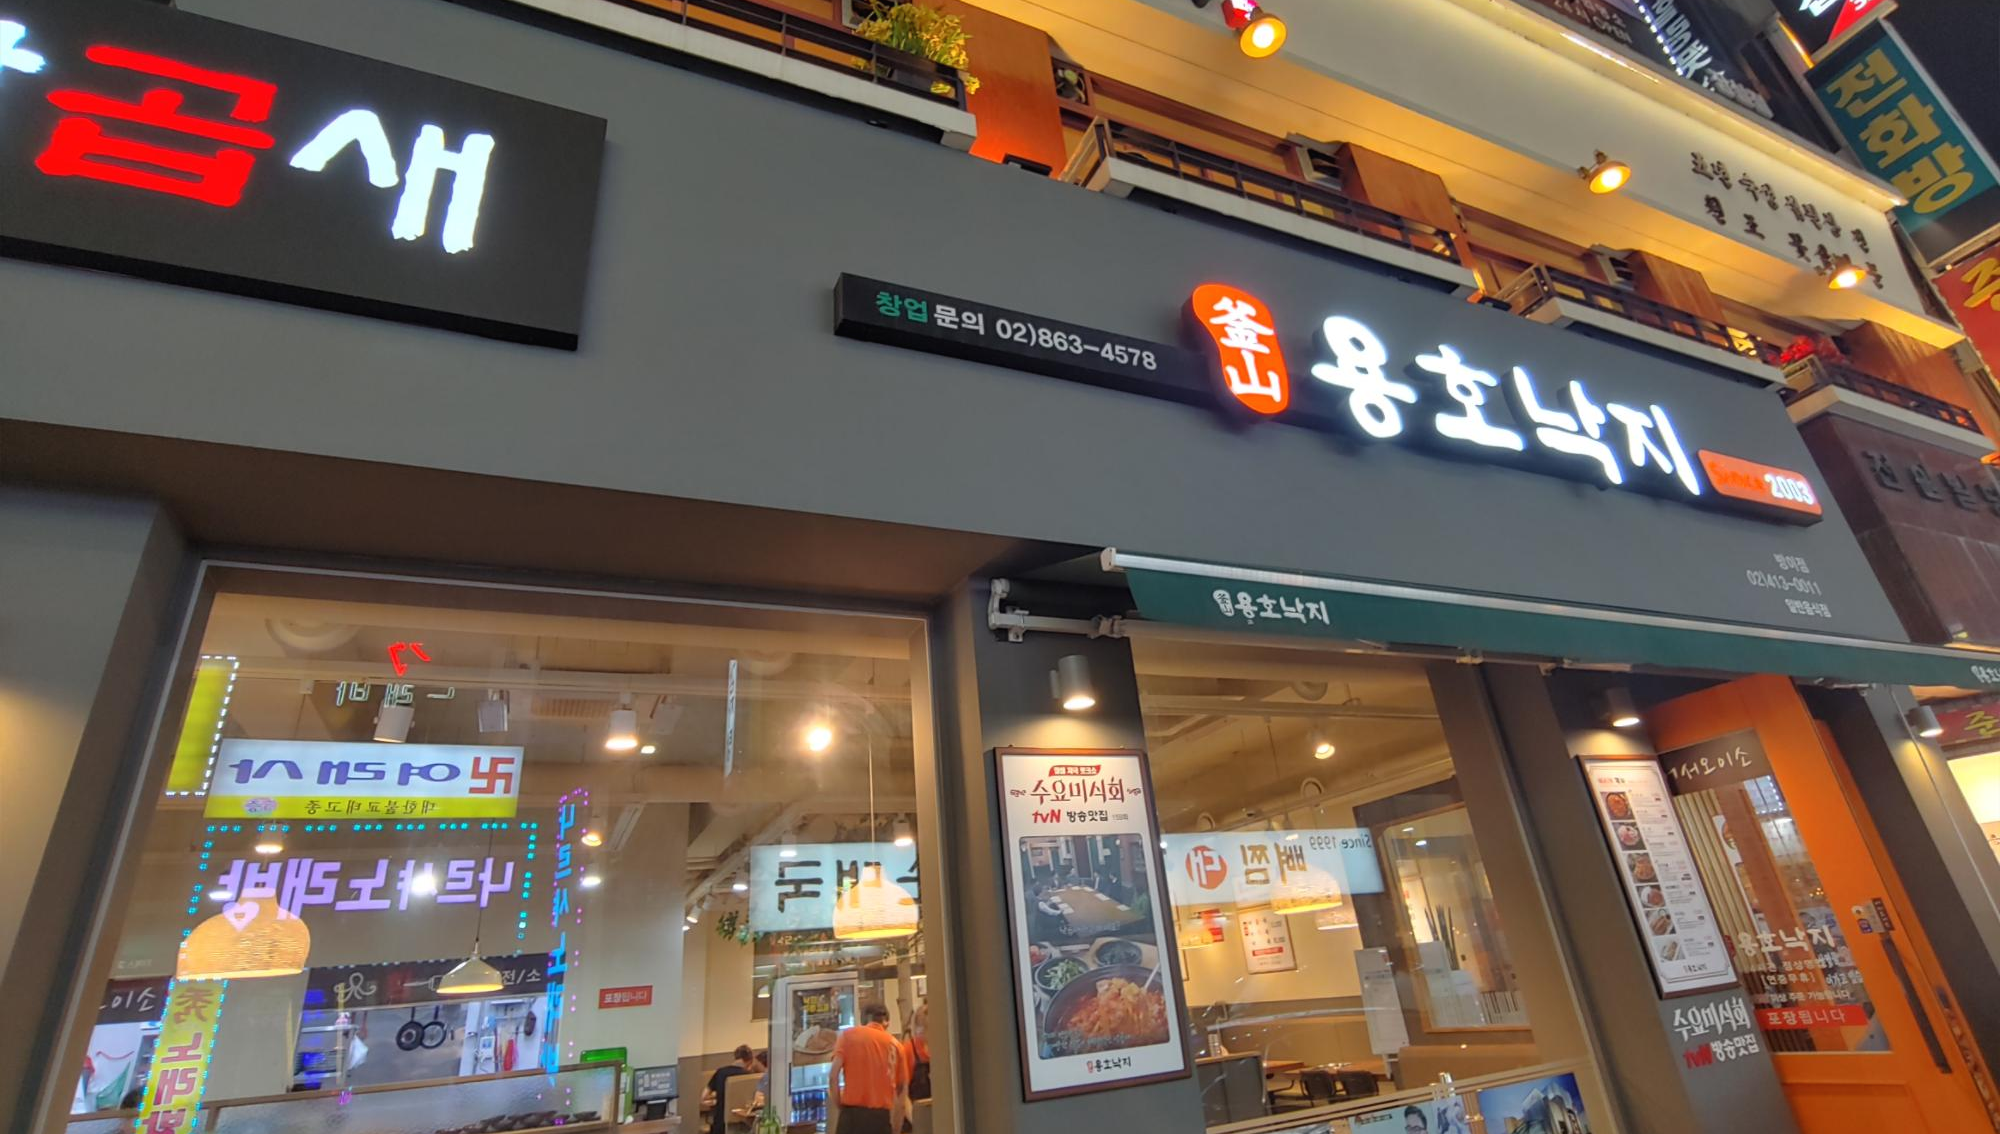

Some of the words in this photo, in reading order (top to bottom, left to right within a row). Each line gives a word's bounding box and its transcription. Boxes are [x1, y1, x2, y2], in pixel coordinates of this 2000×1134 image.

[1826, 48, 1974, 214] 전화방
[875, 291, 929, 324] 창업
[933, 304, 986, 336] 문의
[995, 319, 1158, 372] 02)863-4578
[1208, 295, 1284, 404] 釜山
[1310, 315, 1701, 496] 용호낙지
[1763, 473, 1814, 506] 2003
[1746, 569, 1822, 597] 02)413-0011
[1234, 591, 1331, 625] 용호낙지
[1029, 776, 1125, 806] 수요미식회
[1032, 809, 1061, 824] tvN
[1066, 809, 1109, 823] 방송맛집
[1738, 925, 1836, 957] 용호낙지
[1672, 996, 1751, 1042] 수요미식회
[1766, 1007, 1847, 1026] 포장됩니다
[1710, 1033, 1760, 1063] 방송맛집
[1094, 1056, 1132, 1073] 용호낙지
